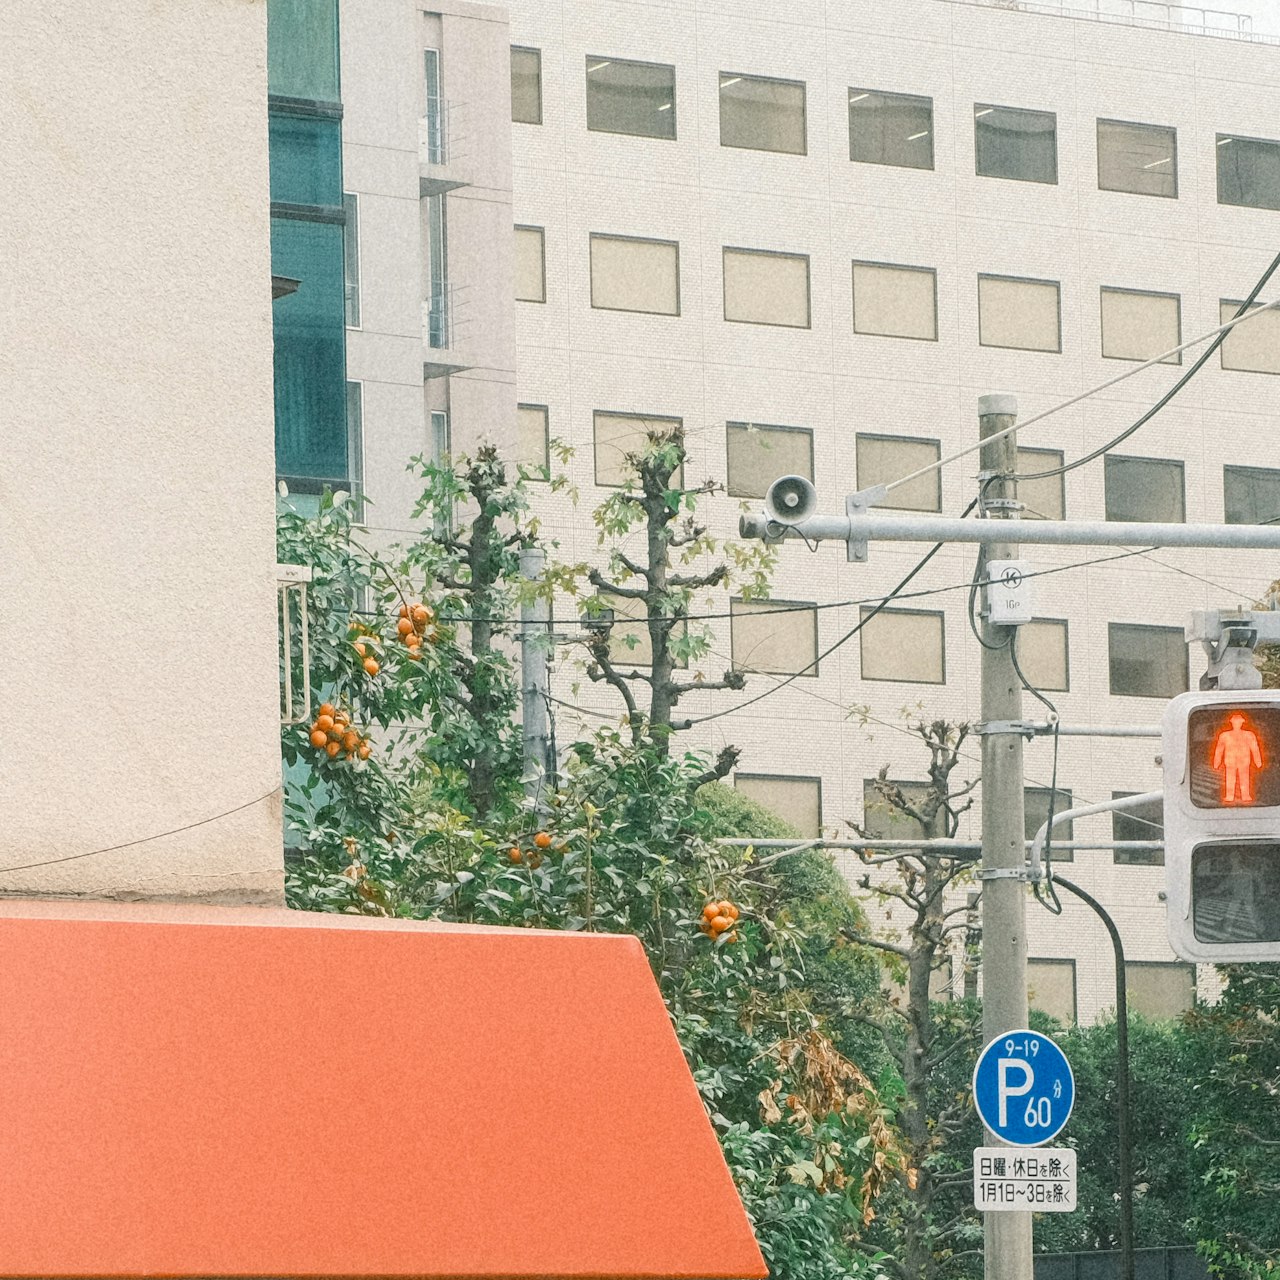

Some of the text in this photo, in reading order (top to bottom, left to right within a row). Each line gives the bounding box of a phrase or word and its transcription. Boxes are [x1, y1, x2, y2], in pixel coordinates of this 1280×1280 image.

[1005, 1039, 1040, 1057] 9-19
[998, 1058, 1035, 1128] P
[980, 1157, 1070, 1178] 日曜・休日を除く
